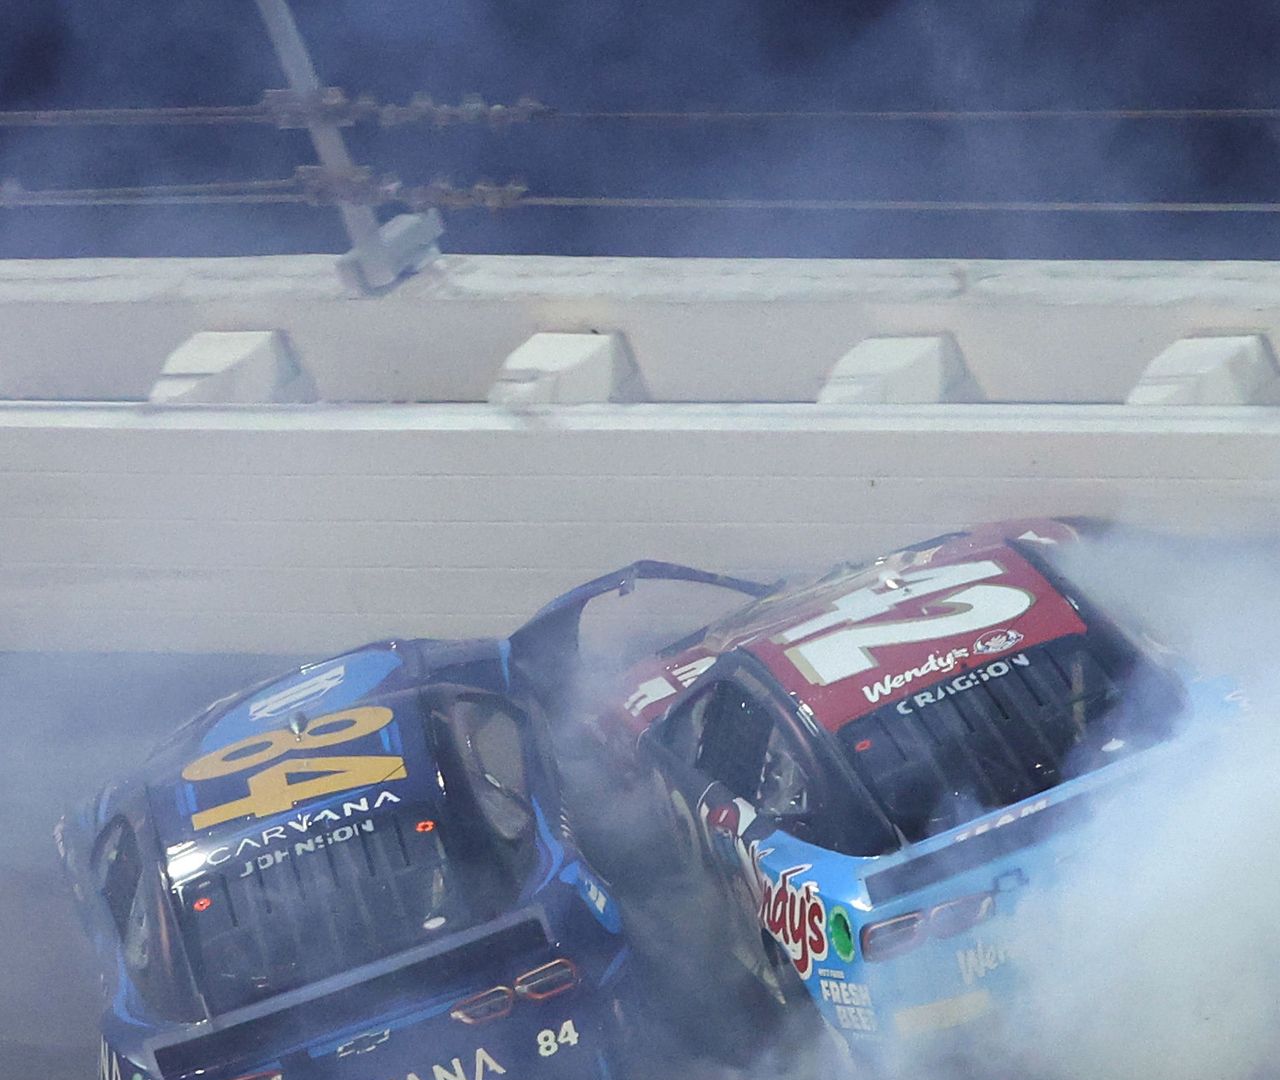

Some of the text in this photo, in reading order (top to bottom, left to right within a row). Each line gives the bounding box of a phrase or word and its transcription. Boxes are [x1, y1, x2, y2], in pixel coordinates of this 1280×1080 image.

[772, 560, 1036, 686] 42
[862, 647, 970, 703] Wendy's
[182, 706, 407, 831] 84
[206, 791, 400, 865] CARVANA
[240, 819, 374, 877] JOHNSON
[537, 1020, 579, 1056] 84
